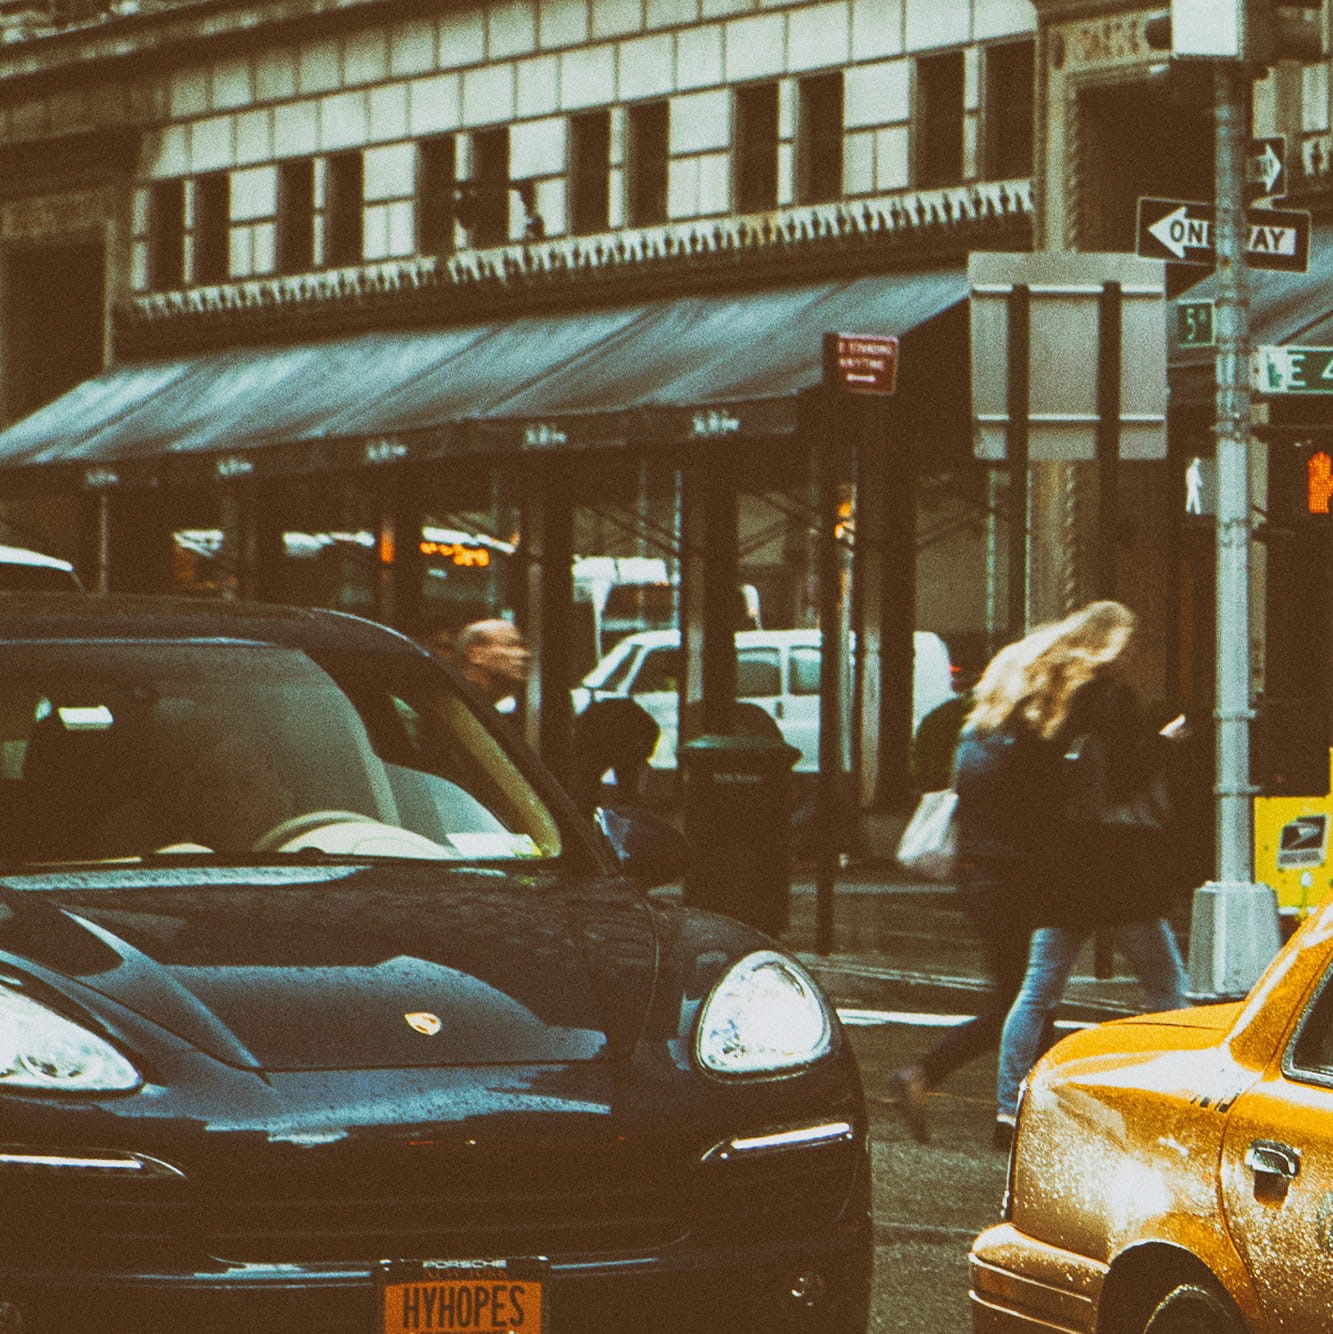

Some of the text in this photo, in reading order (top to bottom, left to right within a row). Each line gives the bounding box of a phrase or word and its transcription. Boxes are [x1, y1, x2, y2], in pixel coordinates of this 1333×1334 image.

[1250, 227, 1286, 252] AY
[1287, 353, 1307, 387] E
[423, 1259, 507, 1269] PORSCHE
[402, 1285, 525, 1328] HYHOPES
